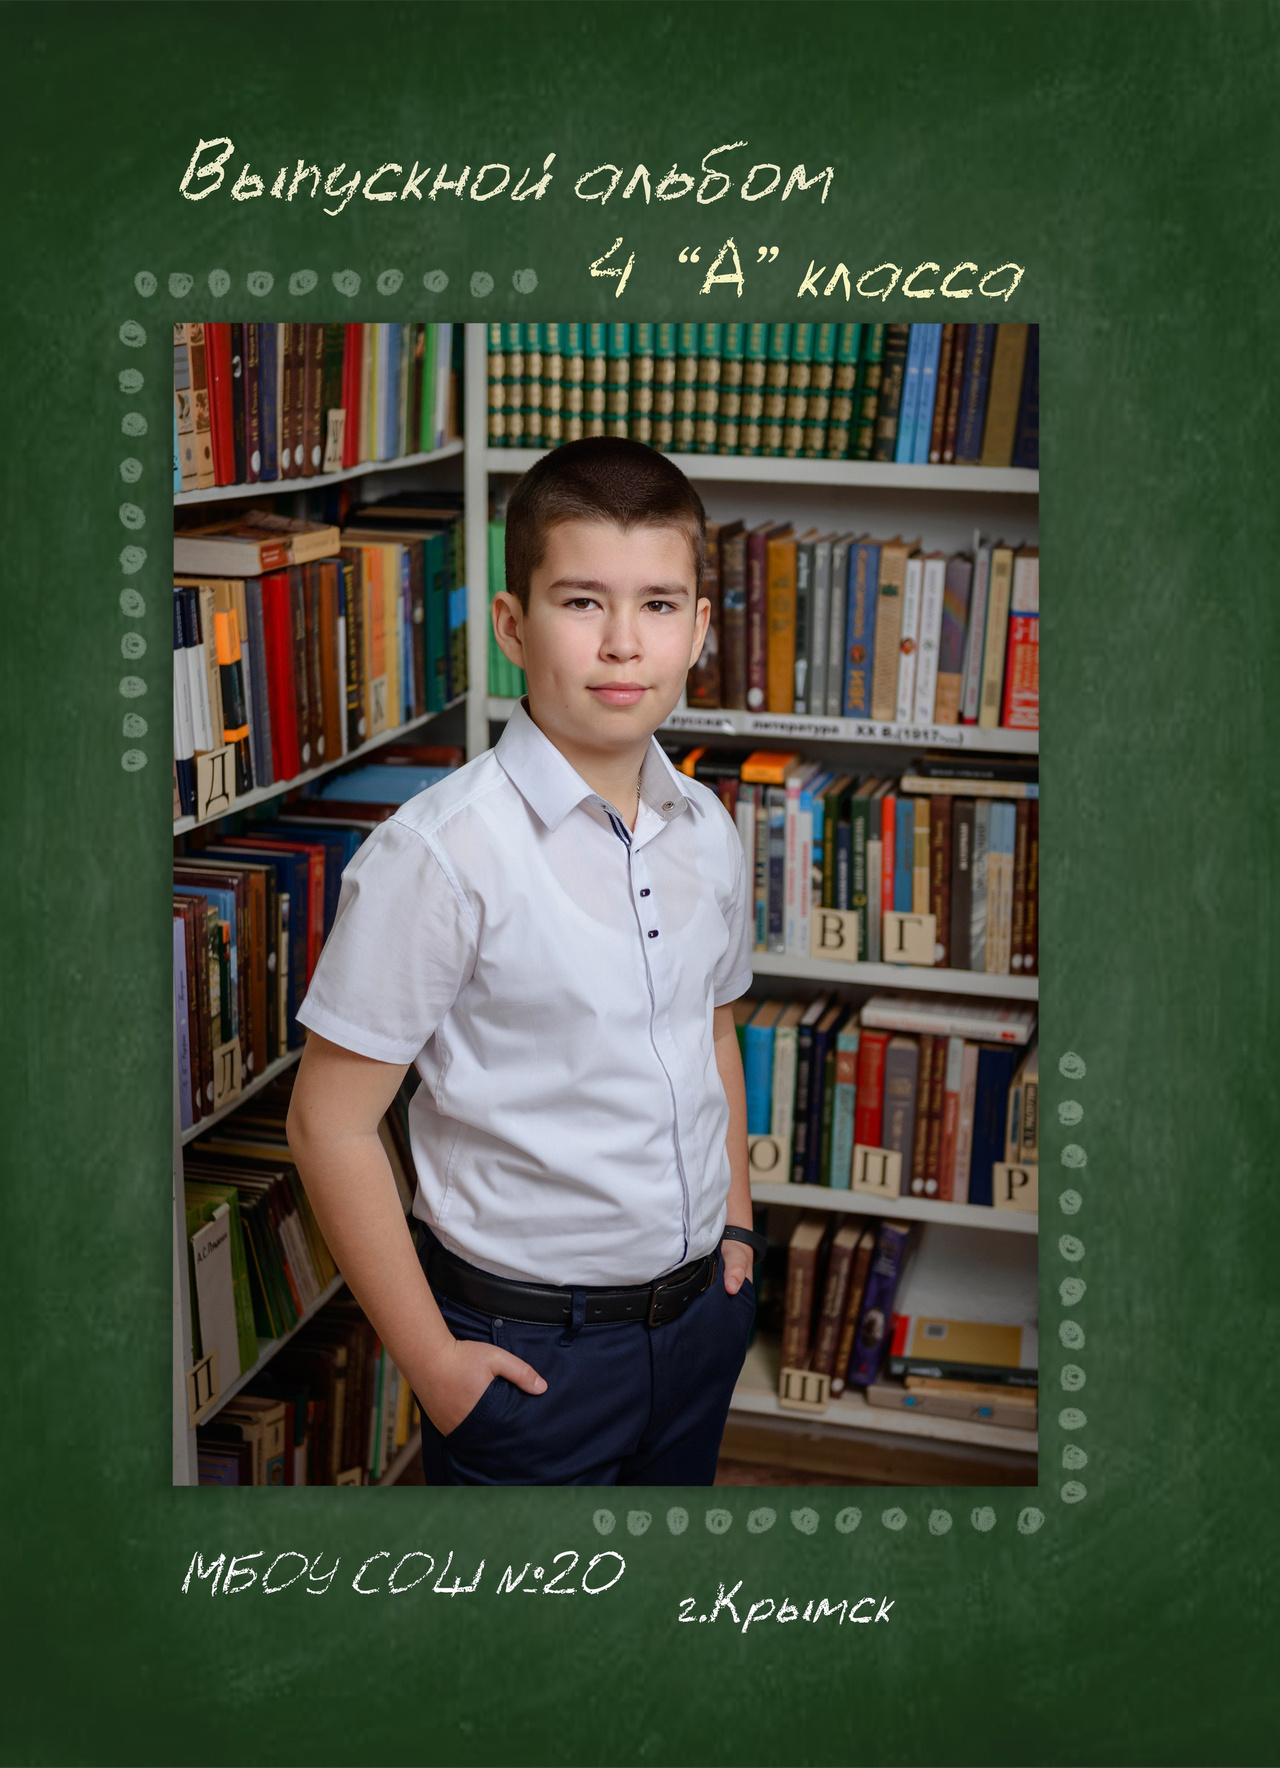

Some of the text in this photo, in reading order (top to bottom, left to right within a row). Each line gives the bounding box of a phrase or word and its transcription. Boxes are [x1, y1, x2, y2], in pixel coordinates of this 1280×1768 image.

[206, 751, 230, 816] Д
[820, 915, 844, 949] В
[896, 917, 923, 950] Г
[218, 1046, 236, 1099] Л
[860, 1150, 889, 1187] П
[1007, 1167, 1029, 1200] Р
[192, 1355, 216, 1414] П
